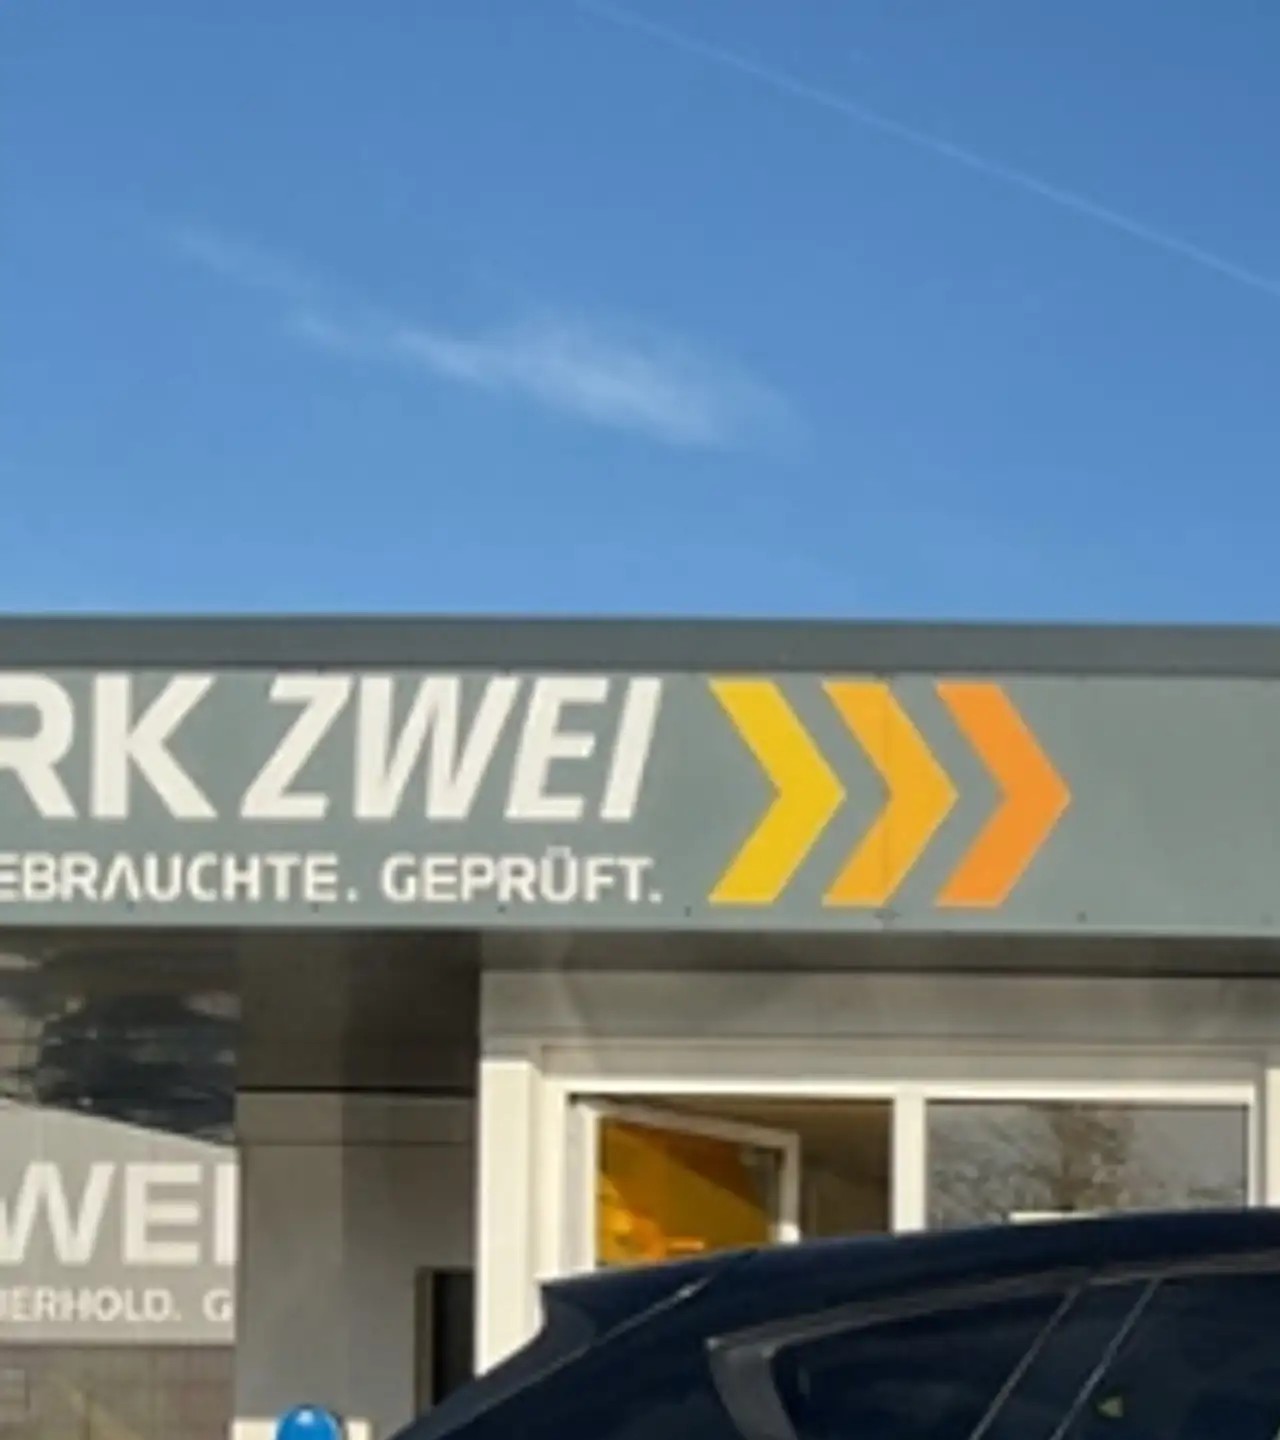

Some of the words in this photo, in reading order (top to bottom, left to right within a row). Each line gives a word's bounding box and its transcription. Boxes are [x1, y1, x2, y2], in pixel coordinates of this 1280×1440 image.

[0, 672, 218, 820] RK
[239, 674, 662, 822] ZWEI
[380, 846, 662, 904] GEPRÜFT.
